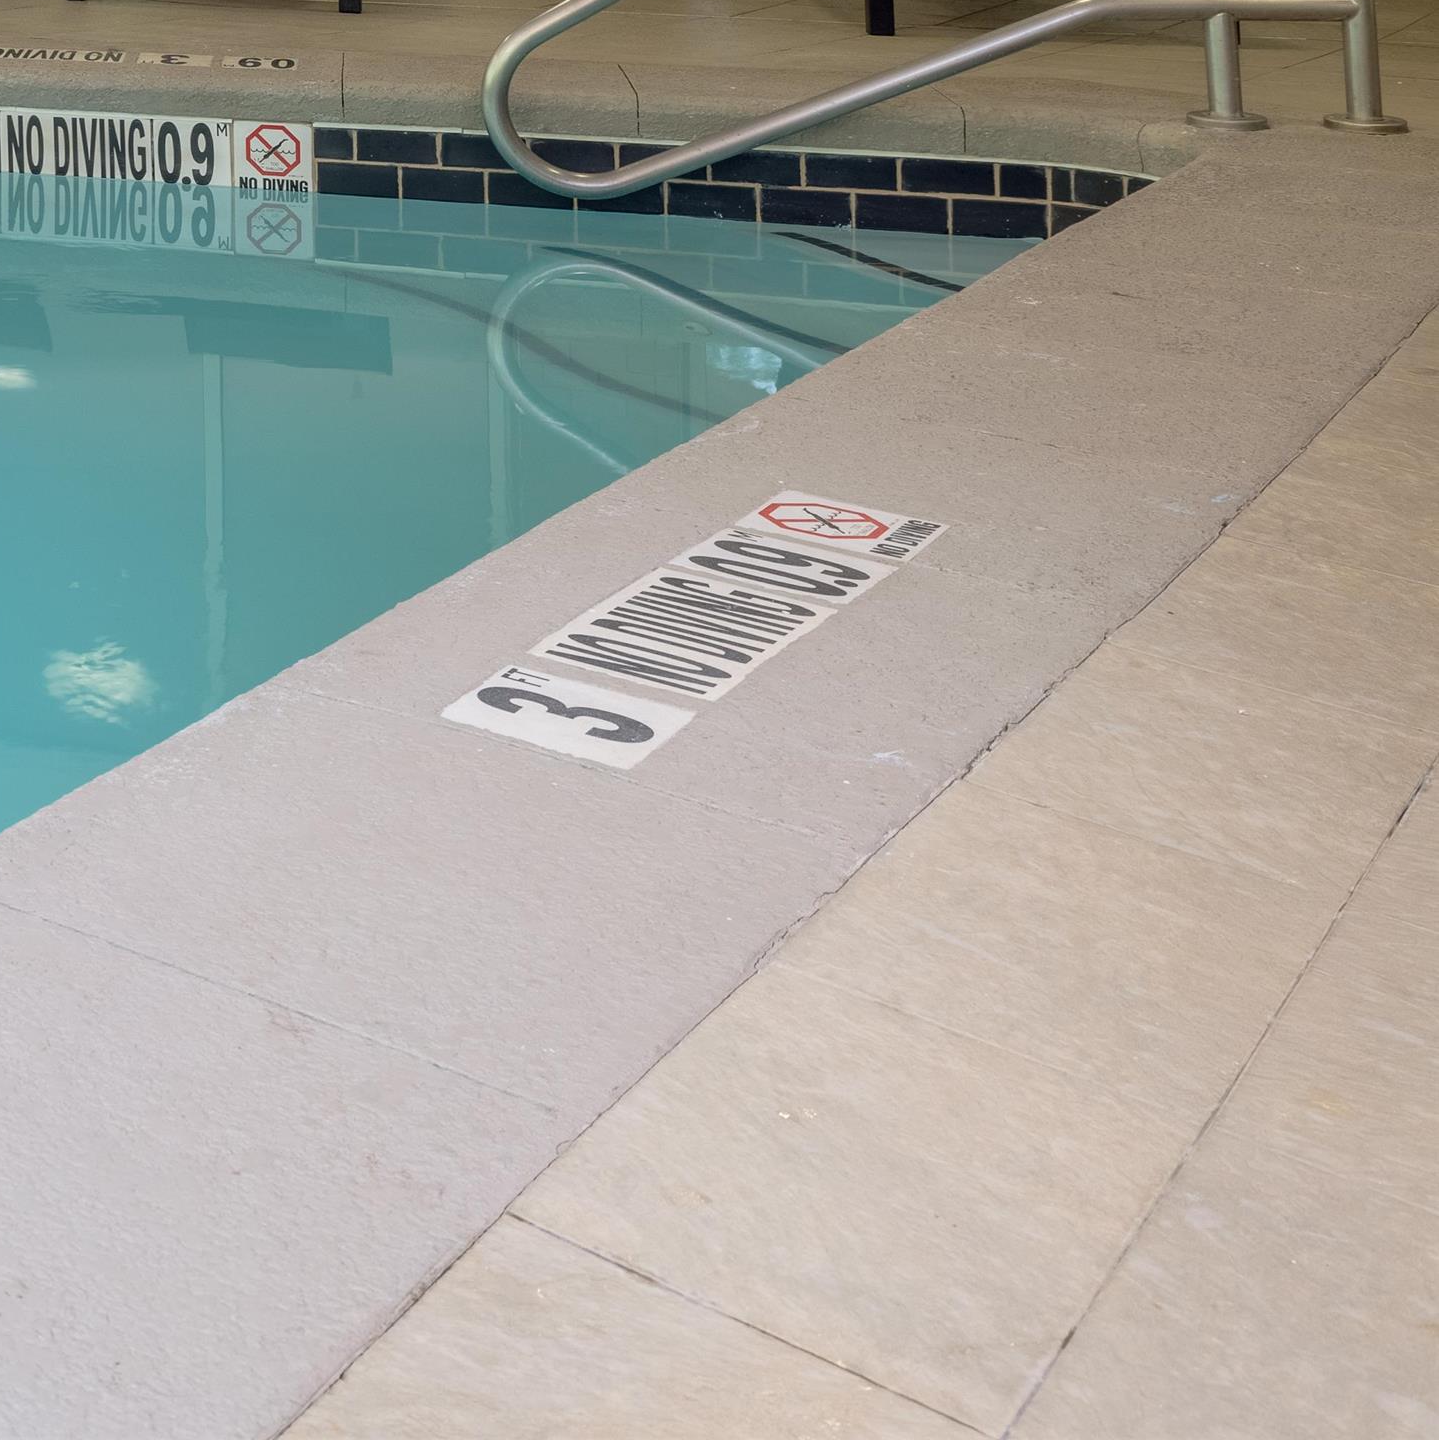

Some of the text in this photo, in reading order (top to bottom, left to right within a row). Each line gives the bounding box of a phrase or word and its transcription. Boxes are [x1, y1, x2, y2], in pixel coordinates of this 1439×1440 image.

[84, 51, 123, 62] NO
[160, 54, 191, 65] 3
[7, 114, 44, 175] NO
[53, 116, 147, 181] DIVING
[157, 121, 215, 186] 0.9
[216, 123, 228, 137] M
[239, 176, 309, 193] NO DIVING
[885, 519, 942, 547] DIVING
[869, 543, 910, 559] NO
[477, 529, 871, 744] 3 FT NO DIVING 0.9 M
